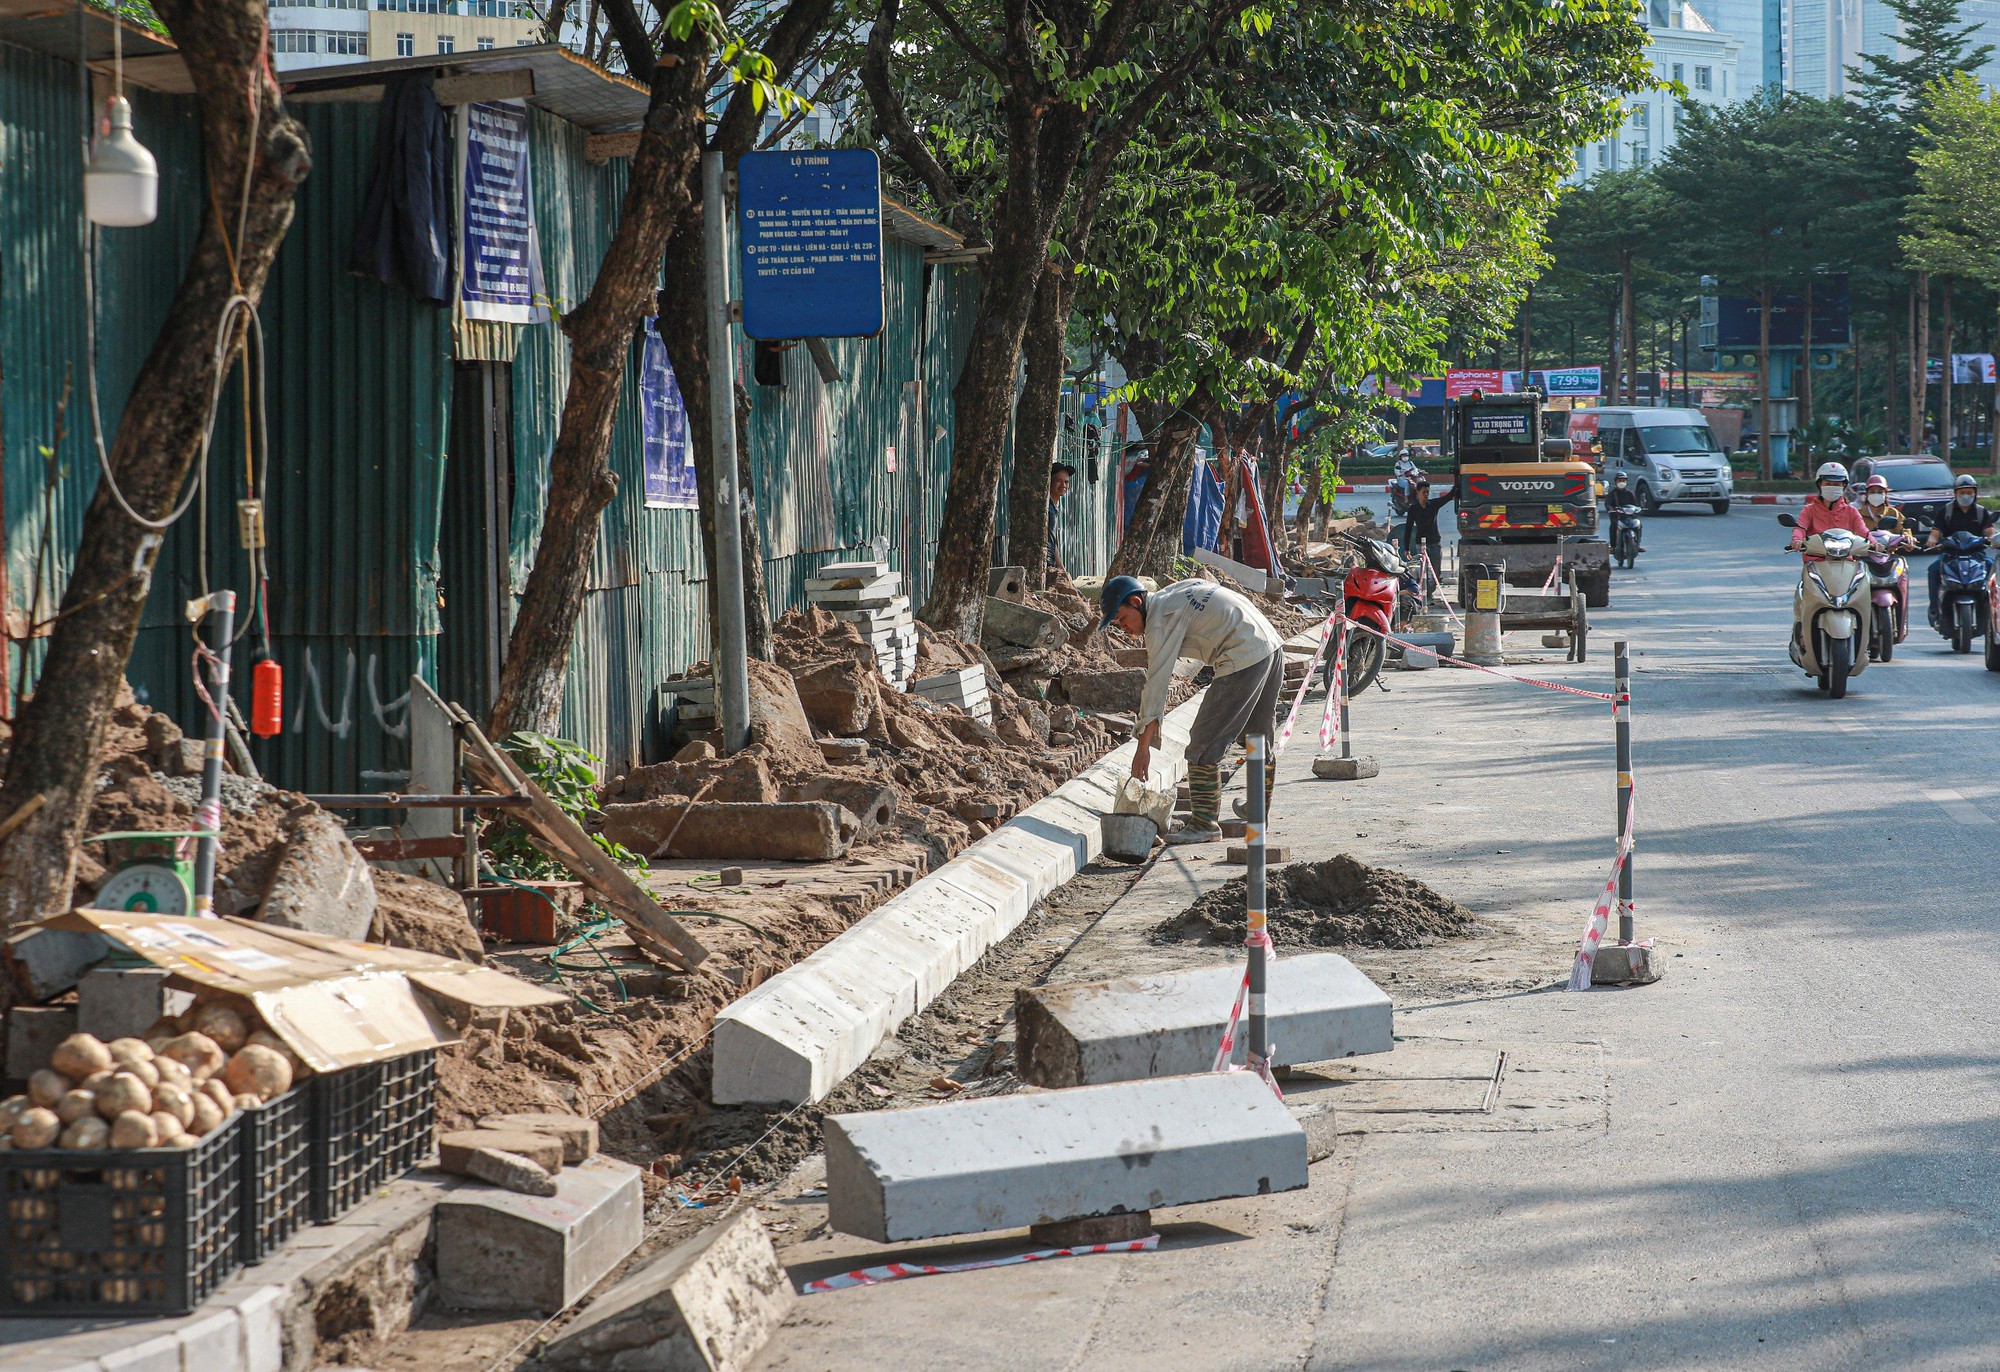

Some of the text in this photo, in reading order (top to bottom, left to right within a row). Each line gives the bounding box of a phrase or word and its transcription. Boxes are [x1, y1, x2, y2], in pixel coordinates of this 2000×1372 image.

[791, 156, 828, 167] LỘ TRÌNH
[811, 255, 827, 264] PHẠM
[1557, 376, 1579, 385] 7.99
[1491, 421, 1512, 429] TRỌNG
[1513, 419, 1523, 427] TÍN
[1499, 481, 1555, 490] VOLVO
